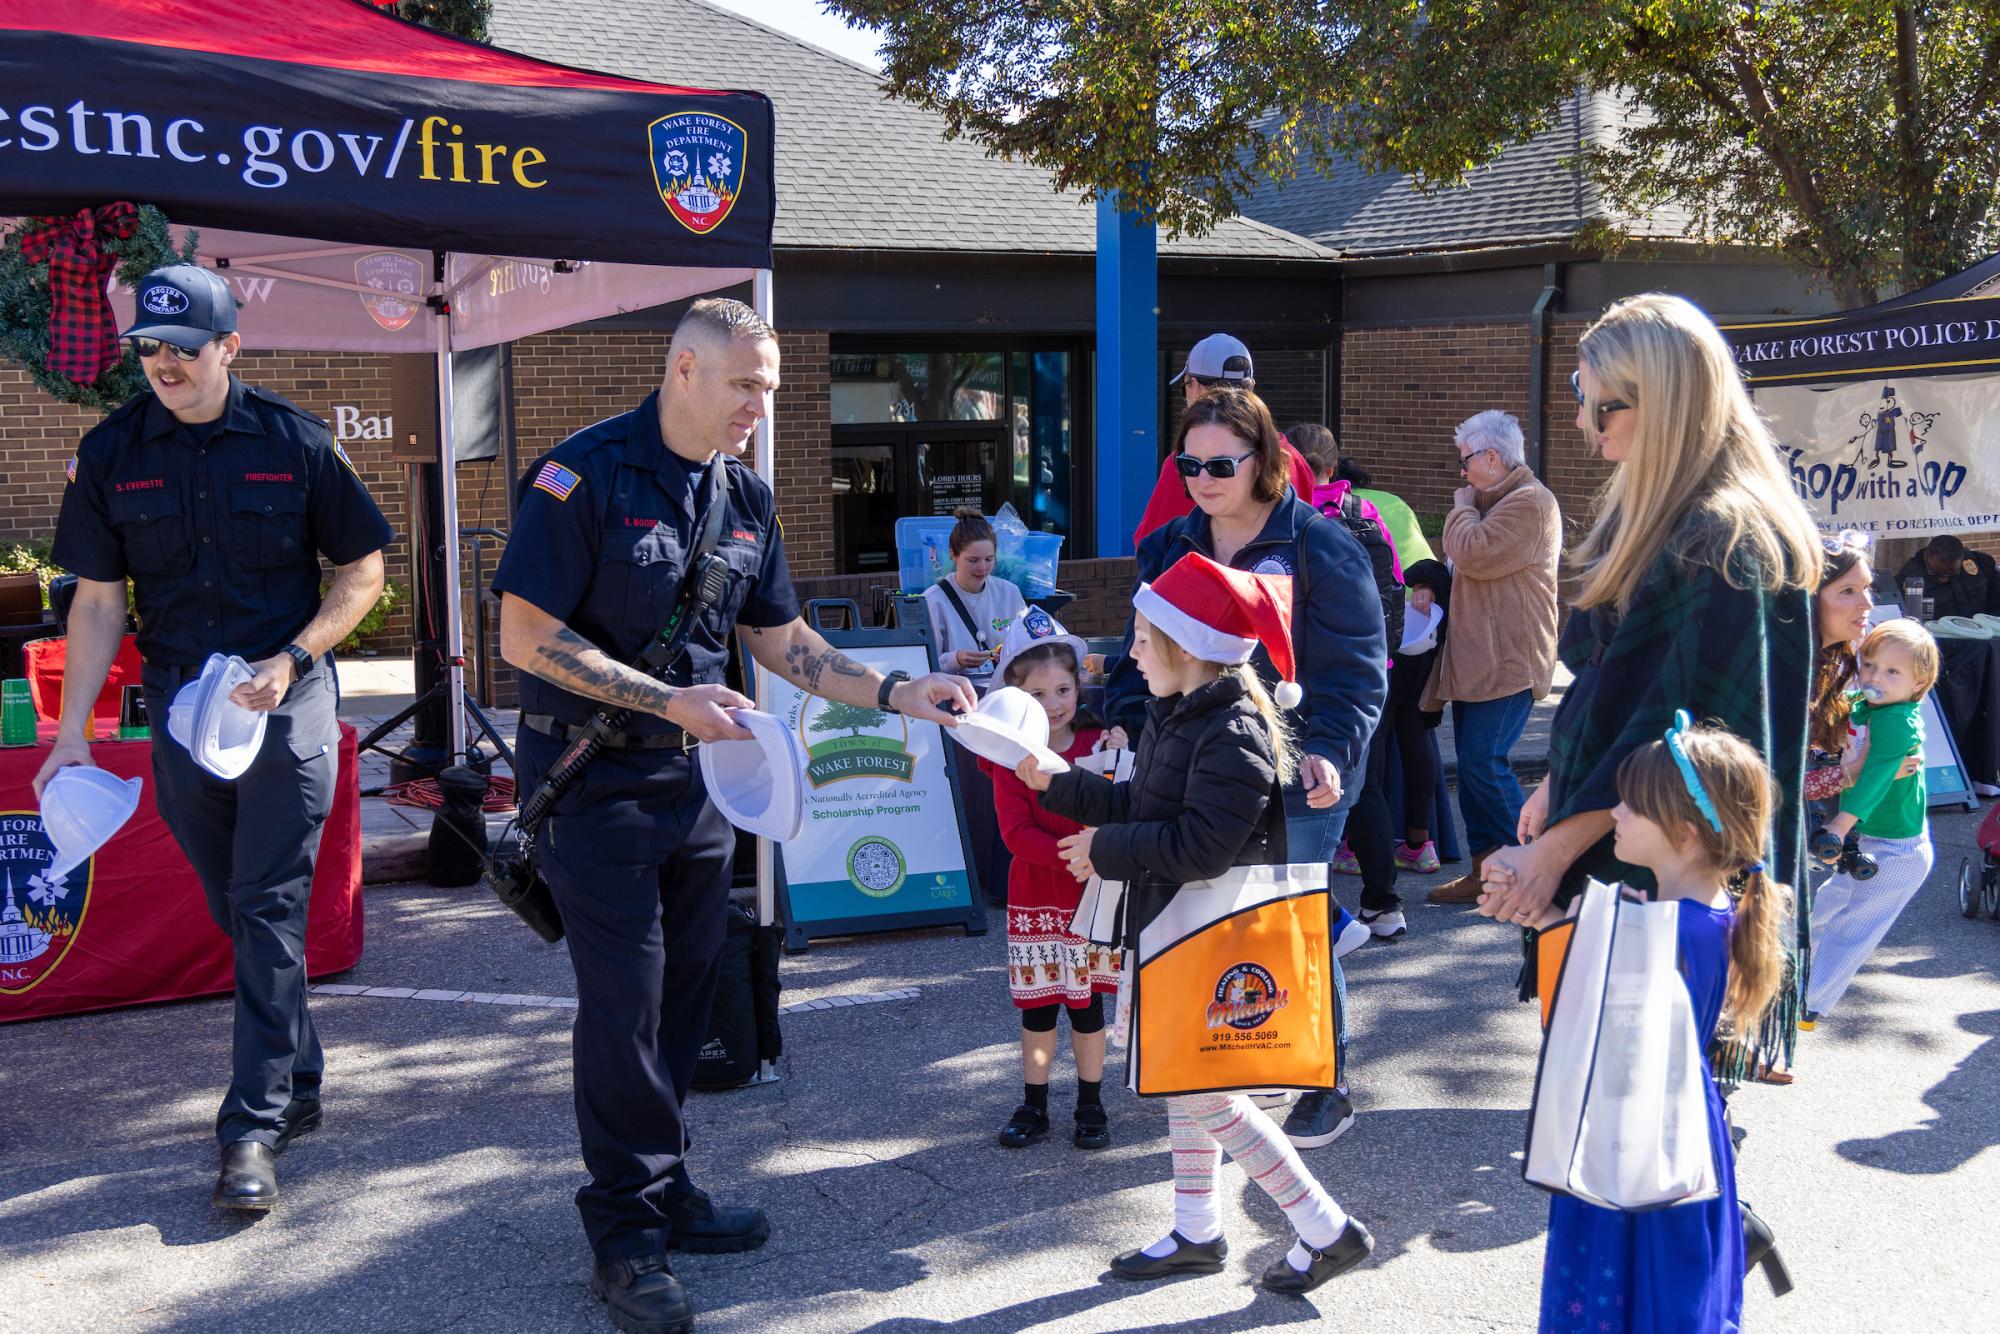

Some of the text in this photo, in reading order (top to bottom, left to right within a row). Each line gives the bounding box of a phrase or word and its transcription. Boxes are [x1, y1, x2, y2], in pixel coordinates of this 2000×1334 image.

[662, 117, 734, 135] WAKE FOREST
[686, 126, 710, 136] FIRE
[666, 136, 734, 153] DEPARTMENT
[150, 288, 181, 298] ENGINE
[157, 293, 170, 307] 4
[148, 303, 180, 312] COMPANY
[1789, 331, 1878, 358] FOREST
[1884, 321, 1979, 349] POLICE
[895, 401, 915, 417] 231
[245, 473, 293, 482] FIREFIGHTER
[1856, 472, 1900, 500] with
[1906, 478, 1918, 499] a
[811, 756, 908, 777] WAKE FOREST
[811, 792, 853, 805] Nationally
[855, 790, 898, 801] Accredited
[899, 788, 929, 800] Agency
[812, 803, 921, 820] Scholarship Program
[15, 952, 33, 961] 1921
[2, 968, 31, 981] N.C.
[1217, 968, 1240, 997] HEATING
[1250, 967, 1274, 993] COOLING
[1206, 988, 1290, 1029] Mitchell
[1212, 1031, 1278, 1042] 919.556.5069
[700, 1049, 727, 1057] APEX
[1199, 1042, 1291, 1053] www.MitchellHVAC.com
